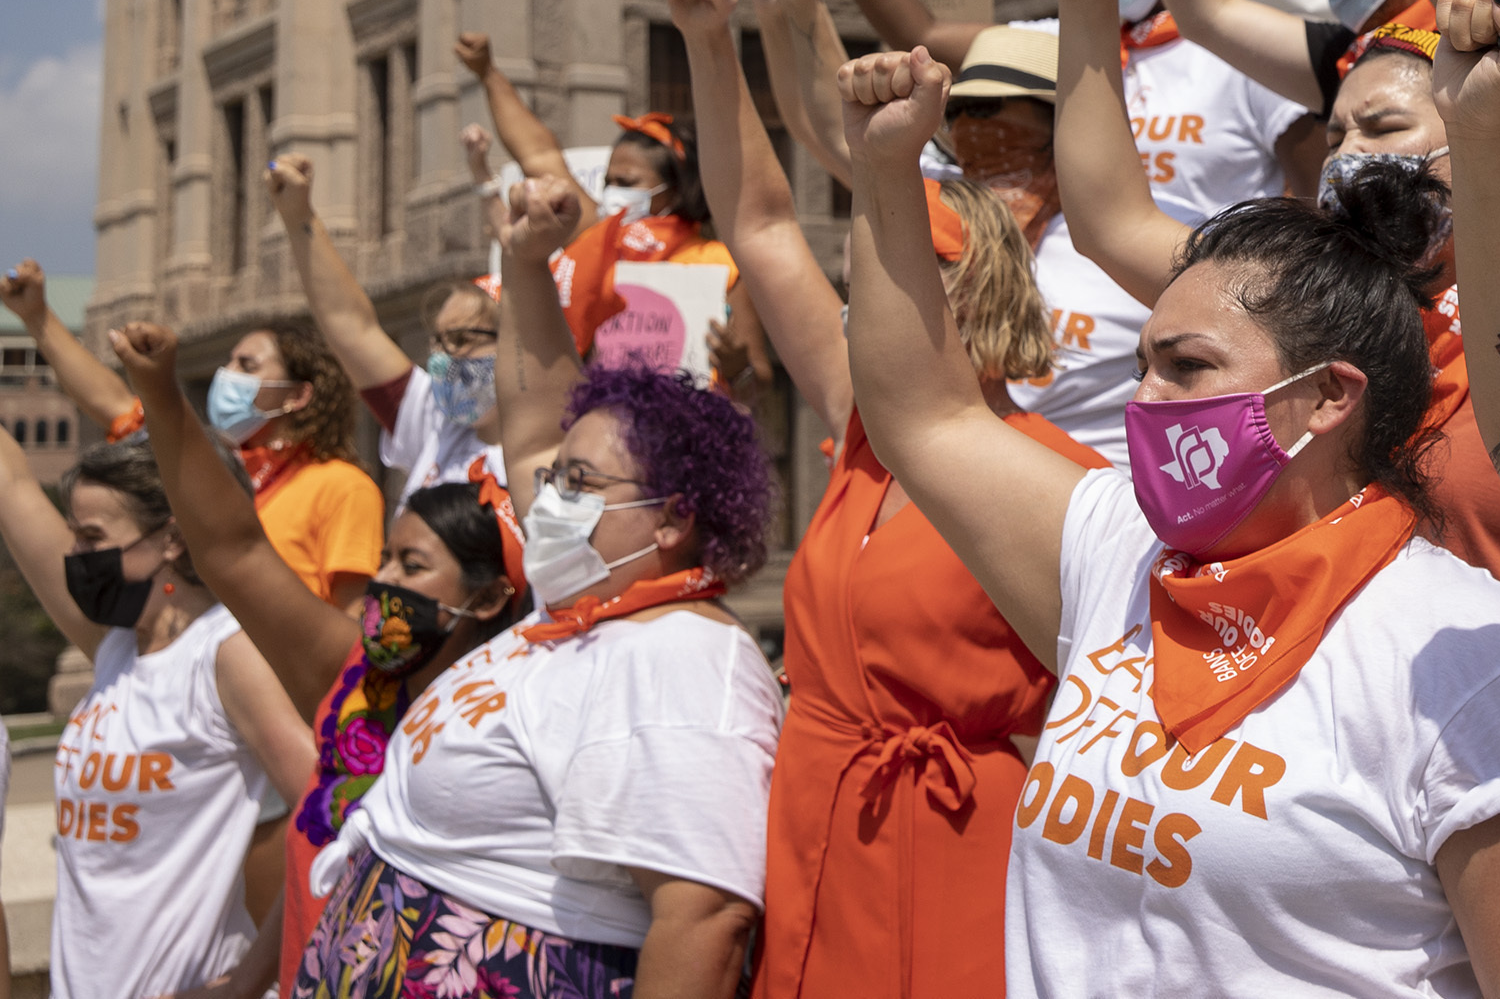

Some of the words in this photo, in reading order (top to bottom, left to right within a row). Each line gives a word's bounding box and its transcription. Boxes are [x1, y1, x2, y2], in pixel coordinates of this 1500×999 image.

[1176, 511, 1195, 525] Act.
[1193, 506, 1206, 517] No
[1205, 494, 1228, 511] matter
[1198, 609, 1239, 647] OUR
[1208, 601, 1276, 655] BODIES
[1203, 647, 1239, 683] BANS
[1230, 643, 1258, 671] OFF
[79, 751, 176, 794] OUR
[1120, 720, 1287, 821] OUR
[58, 798, 141, 845] DIES
[1016, 761, 1202, 889] ODIES
